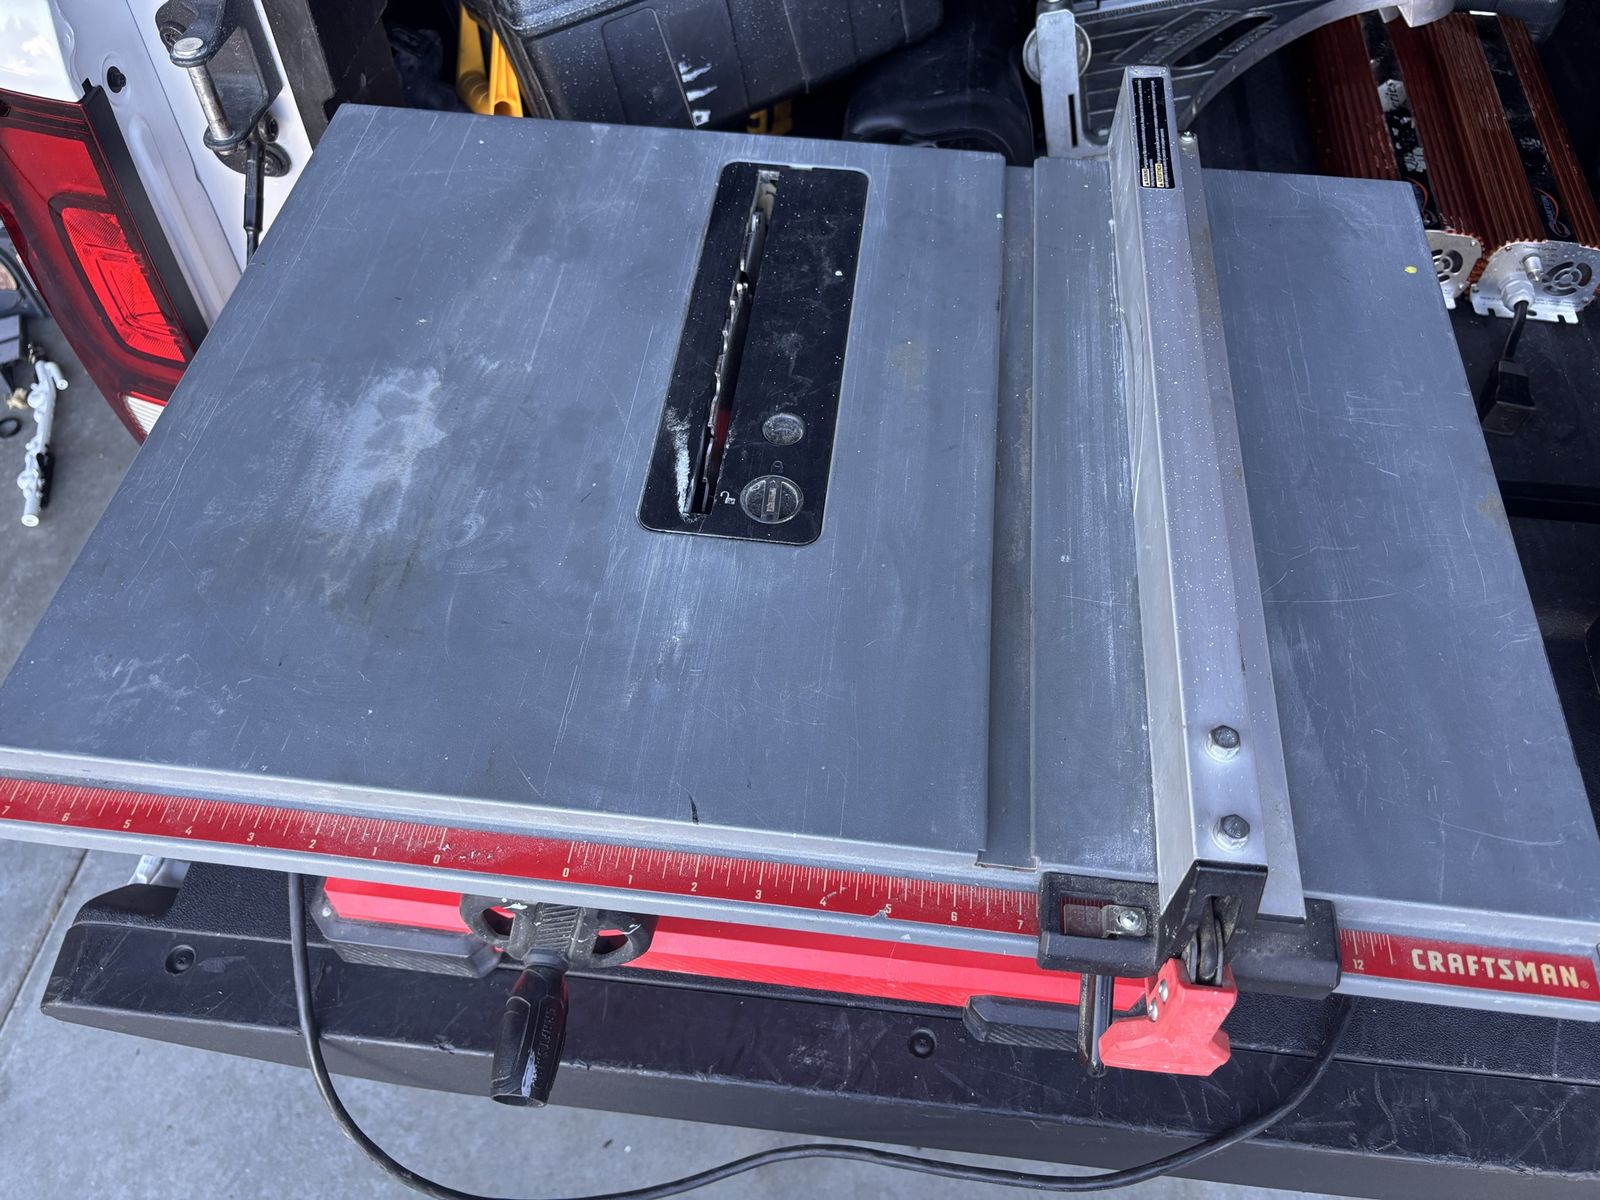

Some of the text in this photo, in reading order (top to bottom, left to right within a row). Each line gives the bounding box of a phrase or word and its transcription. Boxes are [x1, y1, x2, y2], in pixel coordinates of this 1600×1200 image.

[1, 805, 440, 864] 7 6 5 4 3 2 1 0
[562, 867, 1024, 930] 0 1 2 3 4 5 6 7
[1352, 958, 1365, 971] 12
[1411, 948, 1580, 988] CRAFTSMAN
